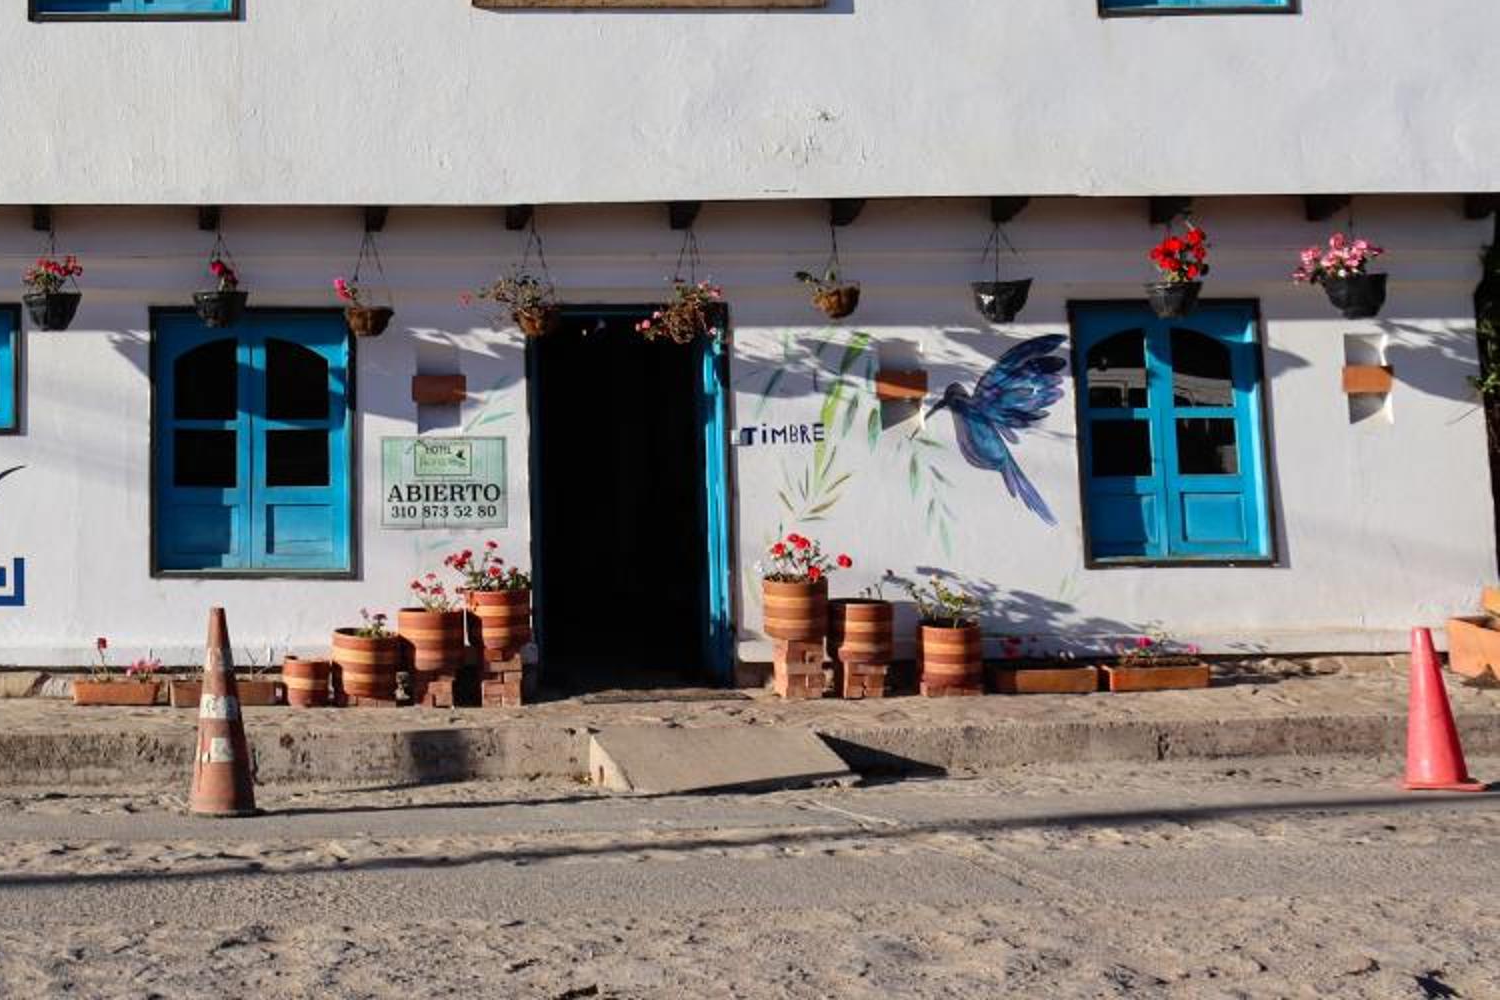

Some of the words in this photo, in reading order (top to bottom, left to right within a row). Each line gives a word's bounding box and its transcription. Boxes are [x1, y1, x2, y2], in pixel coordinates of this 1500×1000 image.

[387, 483, 501, 503] ABIERTO
[391, 505, 417, 519] 310
[423, 505, 449, 519] 873
[454, 505, 473, 519] 52
[477, 505, 497, 519] 80
